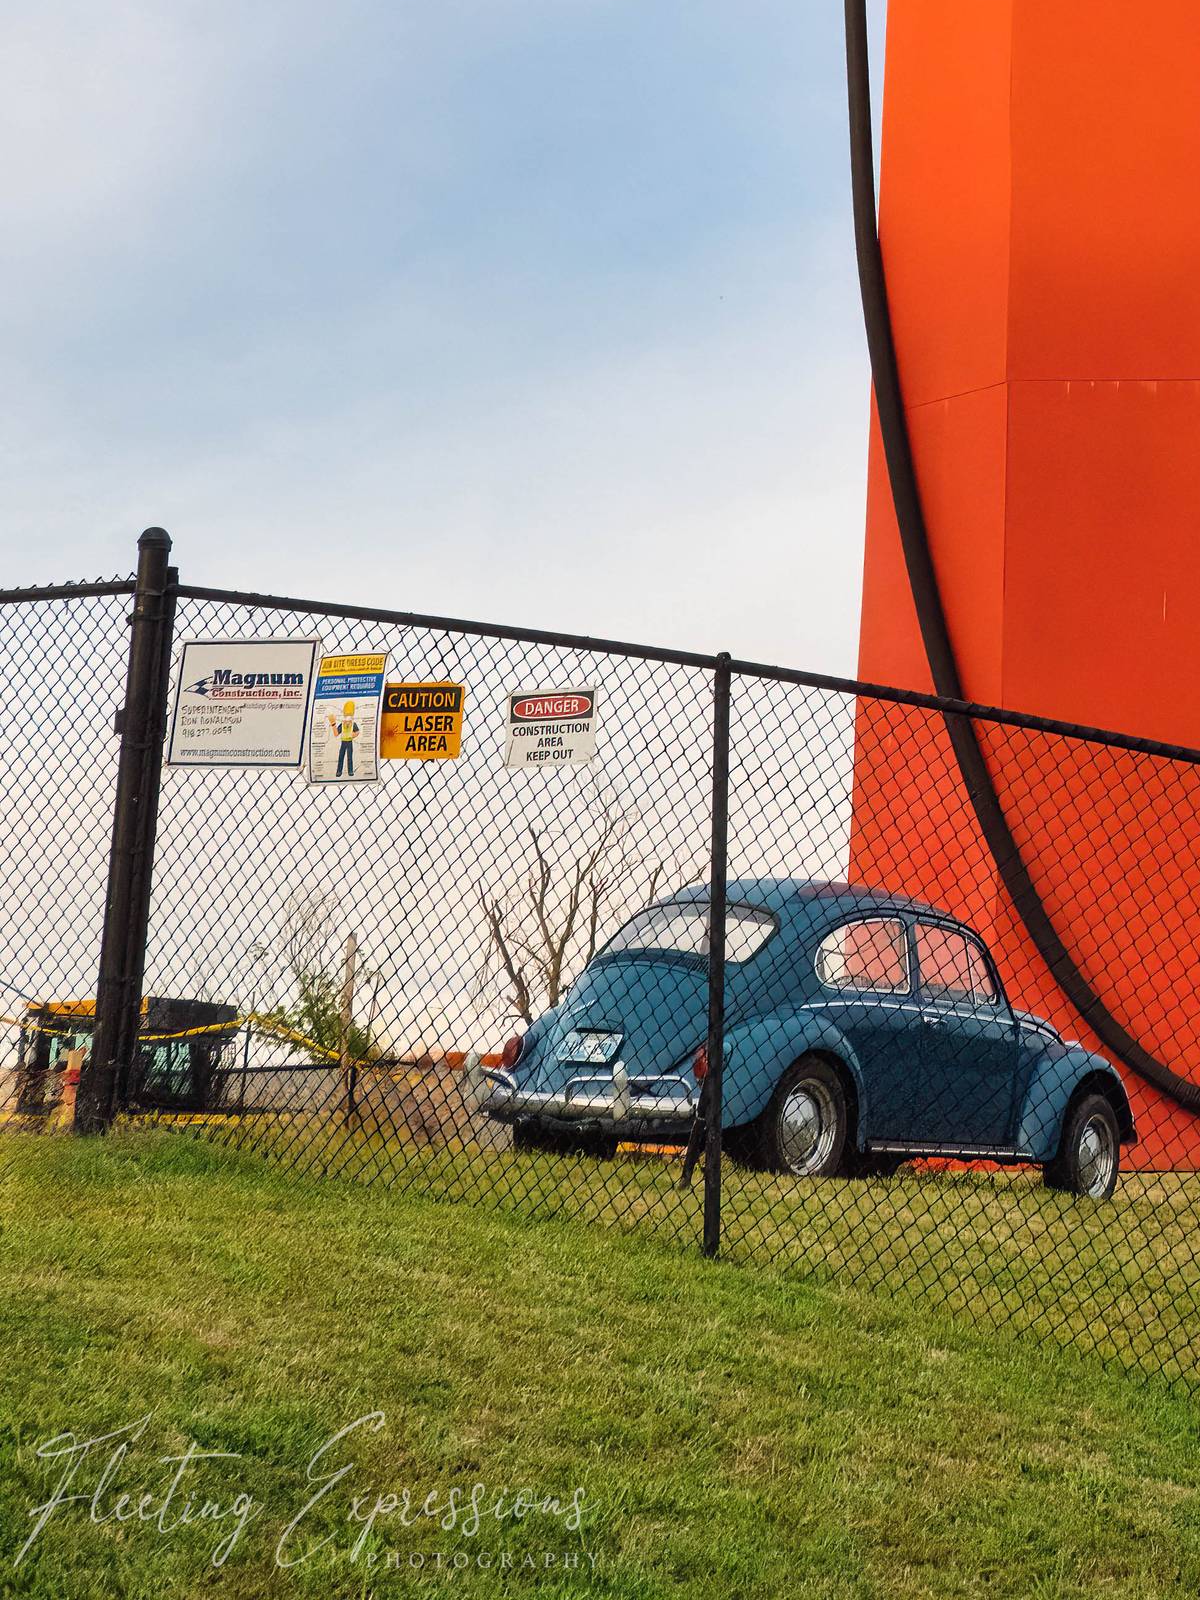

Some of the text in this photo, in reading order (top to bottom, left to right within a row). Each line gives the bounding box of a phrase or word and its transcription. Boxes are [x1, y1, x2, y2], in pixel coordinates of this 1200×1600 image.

[367, 657, 384, 666] CODE
[212, 669, 304, 689] Magnum
[212, 688, 302, 698] Construction, inc.
[388, 692, 456, 708] CAUTION
[525, 700, 579, 715] DANGER
[404, 716, 454, 732] LASER
[512, 723, 590, 737] CONSTRUCTION
[405, 735, 447, 751] AREA
[537, 737, 563, 747] AREA
[180, 749, 291, 759] www.magnumconstruction.com
[526, 749, 574, 761] KEEP OUT
